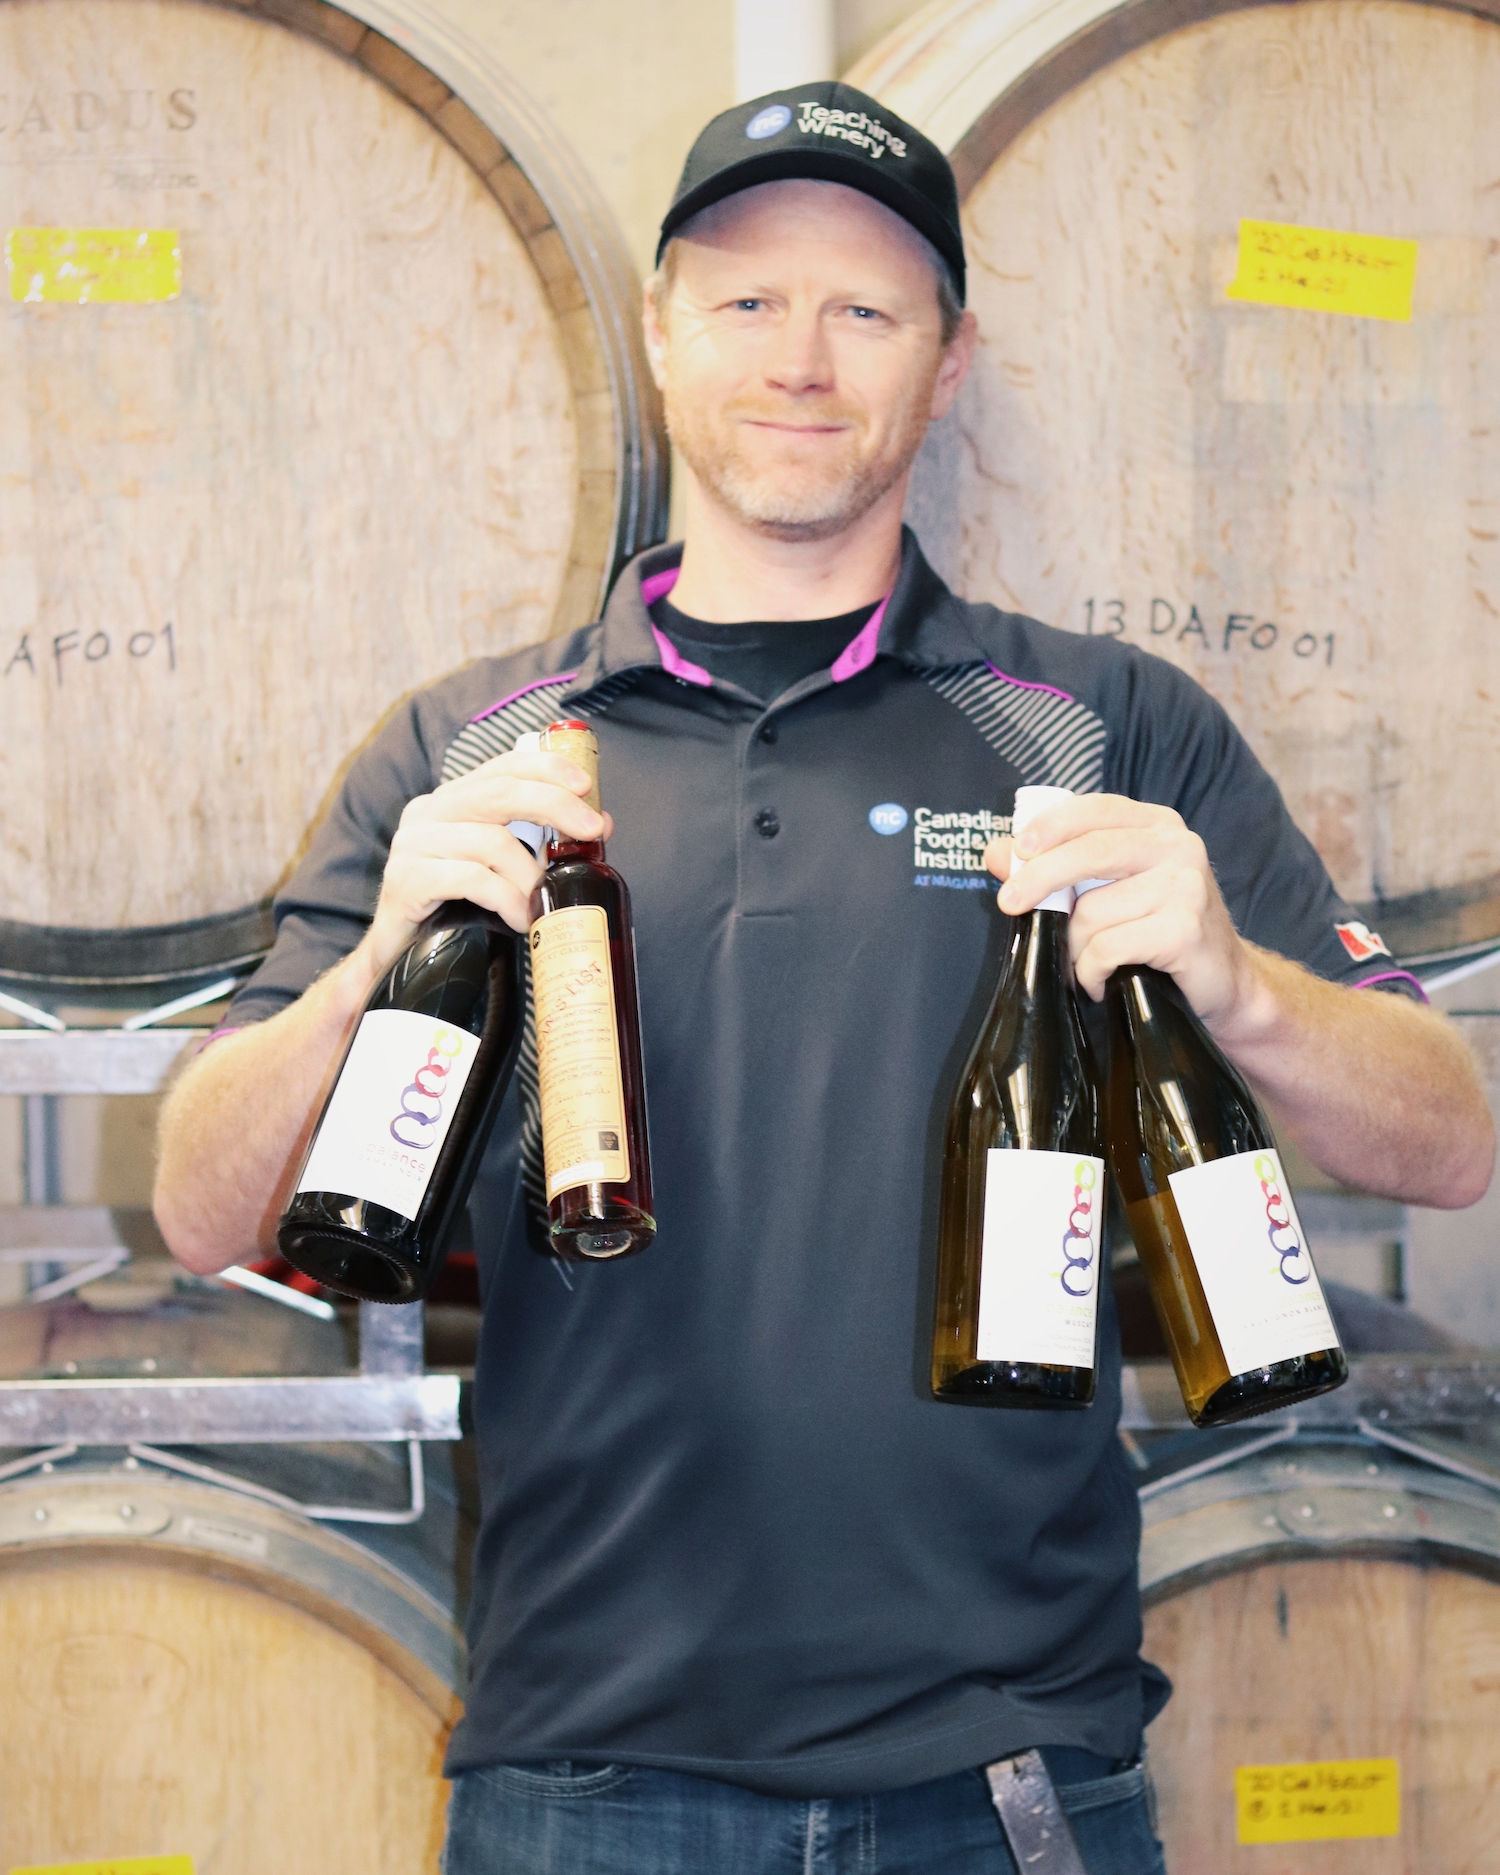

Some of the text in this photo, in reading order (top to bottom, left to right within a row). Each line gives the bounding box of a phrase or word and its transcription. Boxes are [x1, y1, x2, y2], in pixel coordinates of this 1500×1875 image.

[797, 101, 907, 158] Teaching
[797, 118, 885, 159] Winery
[1085, 598, 1125, 636] 13
[874, 811, 901, 825] nc
[914, 846, 987, 872] Institu
[1046, 1299, 1093, 1318] balance
[1065, 1319, 1093, 1329] MUSCAT
